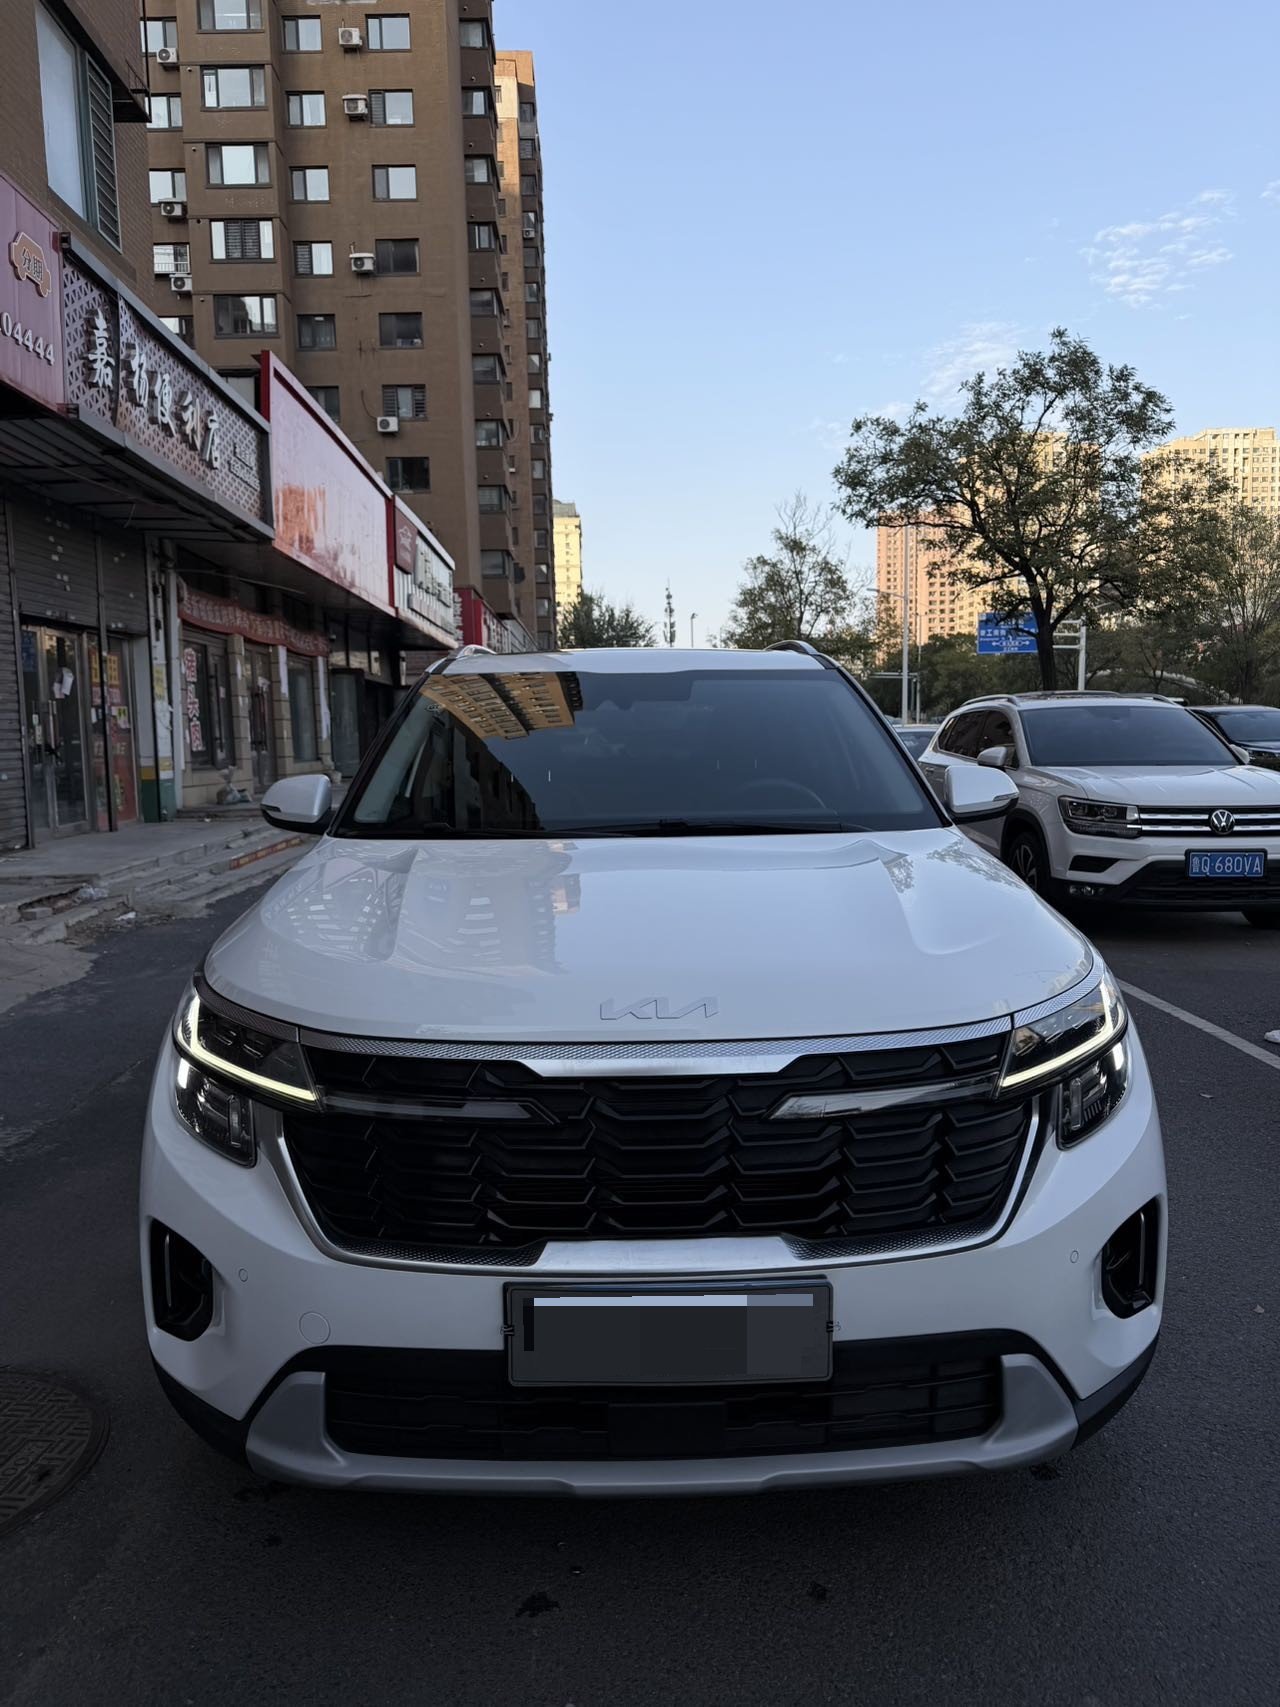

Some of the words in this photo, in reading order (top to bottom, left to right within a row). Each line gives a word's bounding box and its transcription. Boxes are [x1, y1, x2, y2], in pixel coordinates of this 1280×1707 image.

[22, 247, 44, 282] 分期
[0, 311, 55, 366] 04444
[600, 996, 719, 1021] KIA
